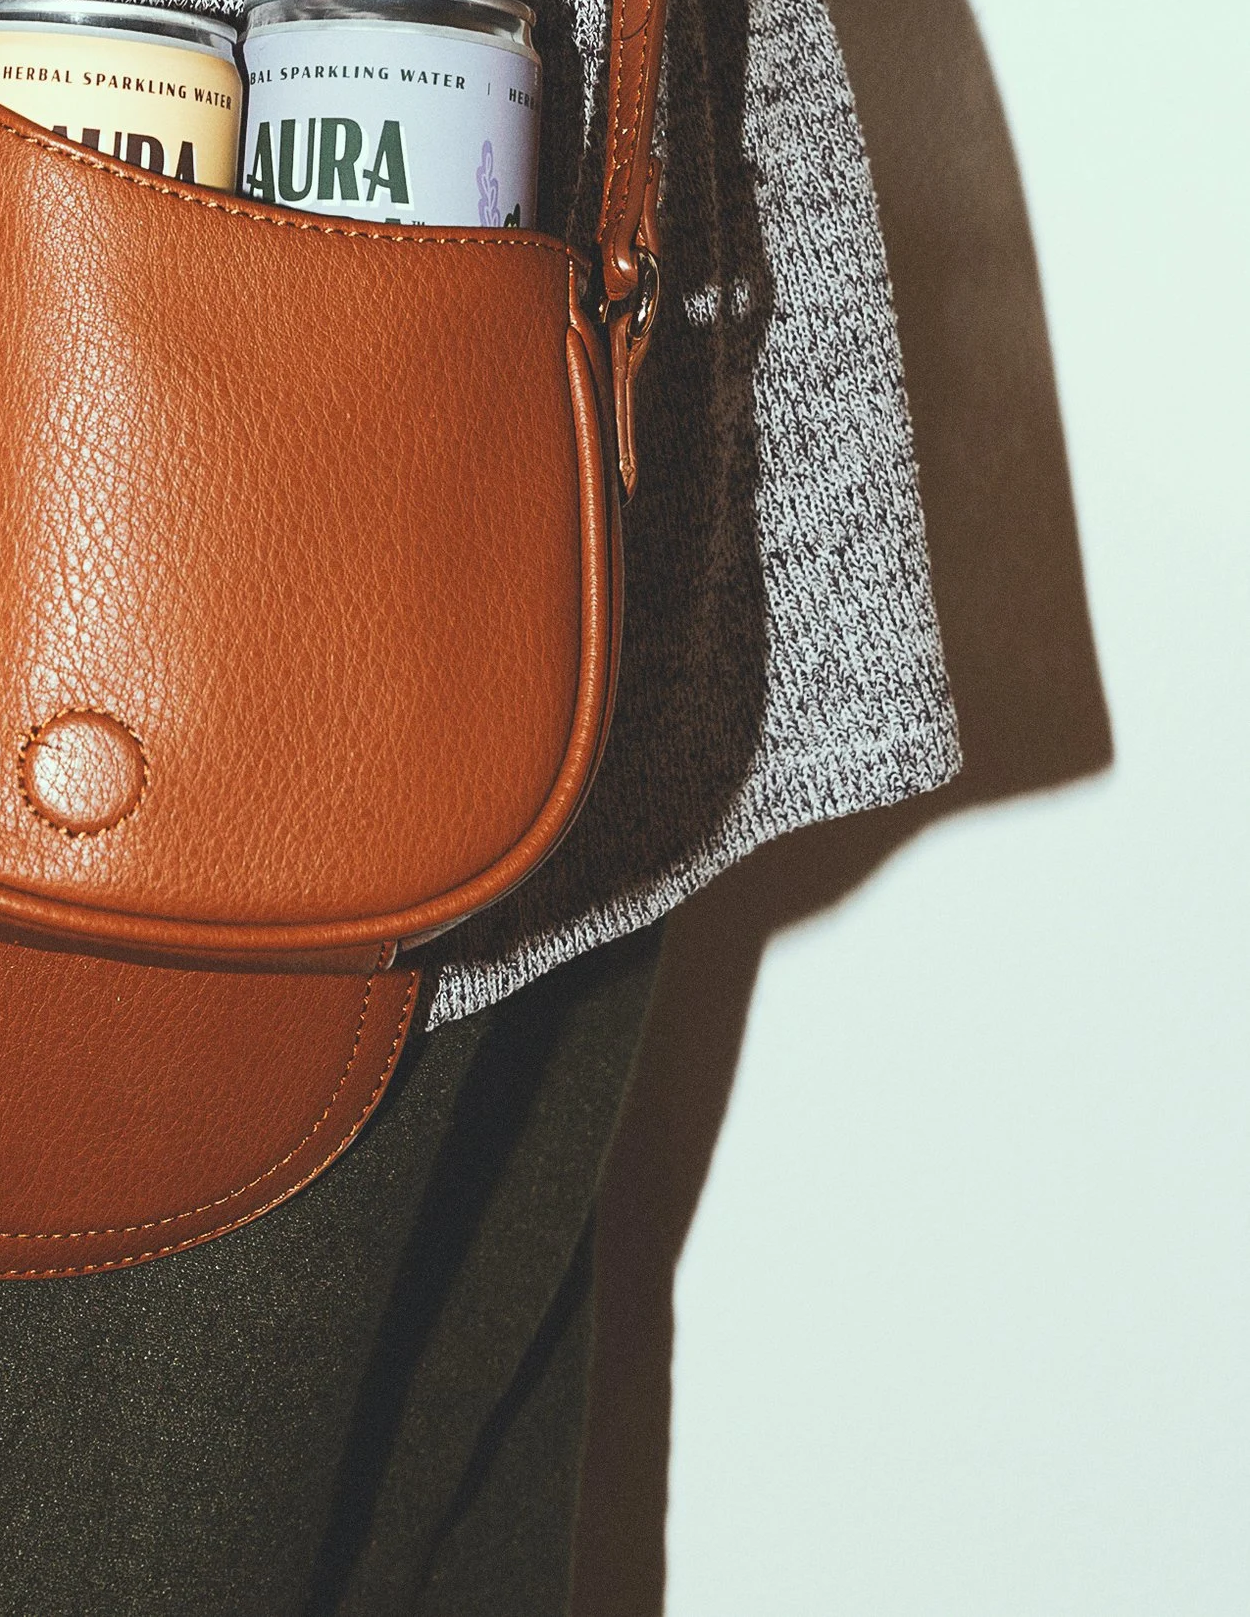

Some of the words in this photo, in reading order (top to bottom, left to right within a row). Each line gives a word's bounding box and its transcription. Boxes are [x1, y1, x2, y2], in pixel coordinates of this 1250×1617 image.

[2, 65, 72, 84] HERBAL
[82, 71, 187, 99] SPARKLING
[194, 87, 232, 110] WATER
[250, 69, 272, 86] BAL
[280, 65, 389, 81] SPARKLING
[400, 68, 466, 90] WATER
[247, 117, 410, 204] AURA
